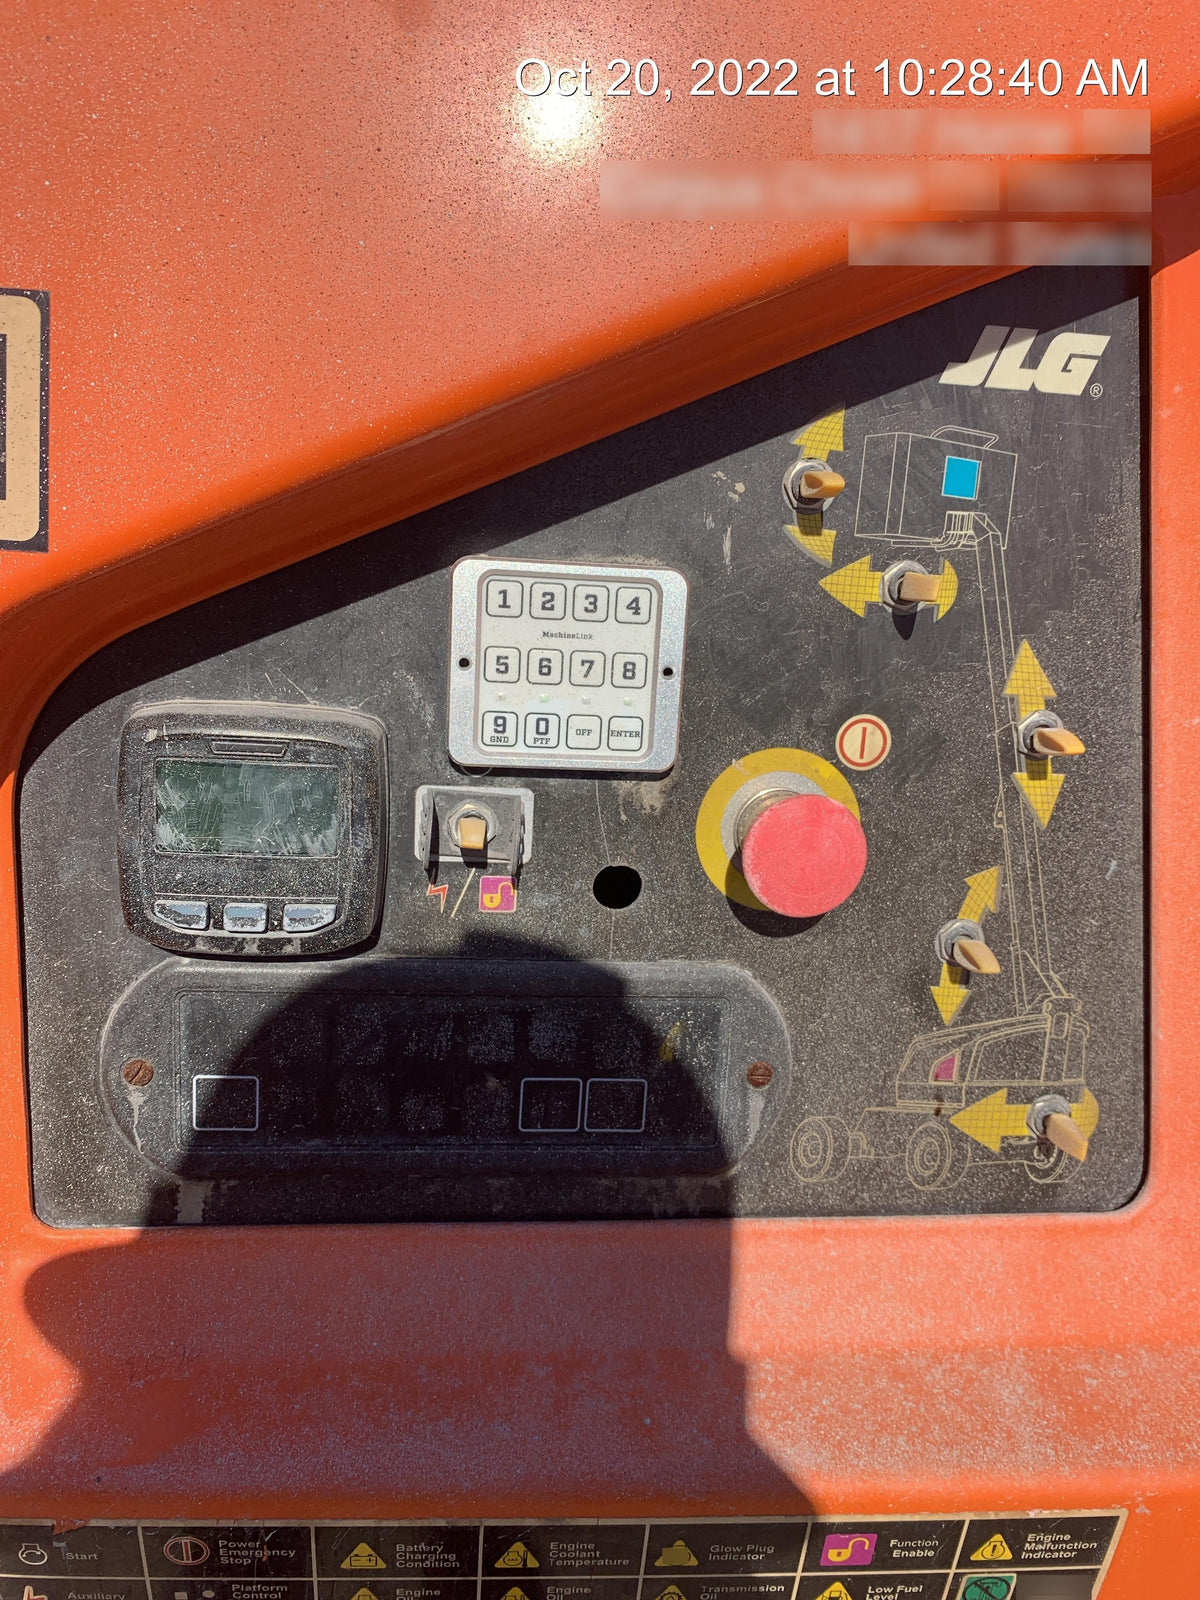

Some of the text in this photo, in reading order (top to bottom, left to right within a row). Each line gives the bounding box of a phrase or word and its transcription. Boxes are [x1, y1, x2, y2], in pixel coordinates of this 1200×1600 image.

[938, 325, 1112, 396] JLG
[498, 589, 641, 615] 1 2 3 4
[542, 631, 593, 640] MachineLink
[495, 655, 636, 680] 5 6 7 8
[493, 715, 549, 736] 9 0
[575, 728, 641, 738] OFF ENTER
[490, 736, 551, 745] GND PTF
[1027, 1533, 1071, 1543] Engine
[219, 1540, 261, 1548] Power
[396, 1543, 444, 1553] Battery
[550, 1541, 595, 1551] Engine
[890, 1539, 939, 1548] Function
[1024, 1541, 1099, 1551] Malfunction
[219, 1548, 296, 1558] Emergency
[710, 1544, 775, 1554] Glow Plug
[892, 1549, 935, 1558] Enable
[66, 1552, 99, 1560] Start
[396, 1552, 456, 1561] Charging
[550, 1550, 600, 1558] Coolant
[709, 1553, 765, 1561] Indicator
[1021, 1549, 1077, 1560] Indicator
[220, 1556, 252, 1565] Stop
[396, 1560, 460, 1568] Condition
[550, 1558, 630, 1568] Temperature
[232, 1584, 288, 1592] Platform
[396, 1588, 441, 1597] Engine
[547, 1586, 592, 1595] Engine
[701, 1584, 785, 1593] Transmission
[867, 1584, 923, 1593] Low Fuel
[232, 1591, 282, 1599] Control
